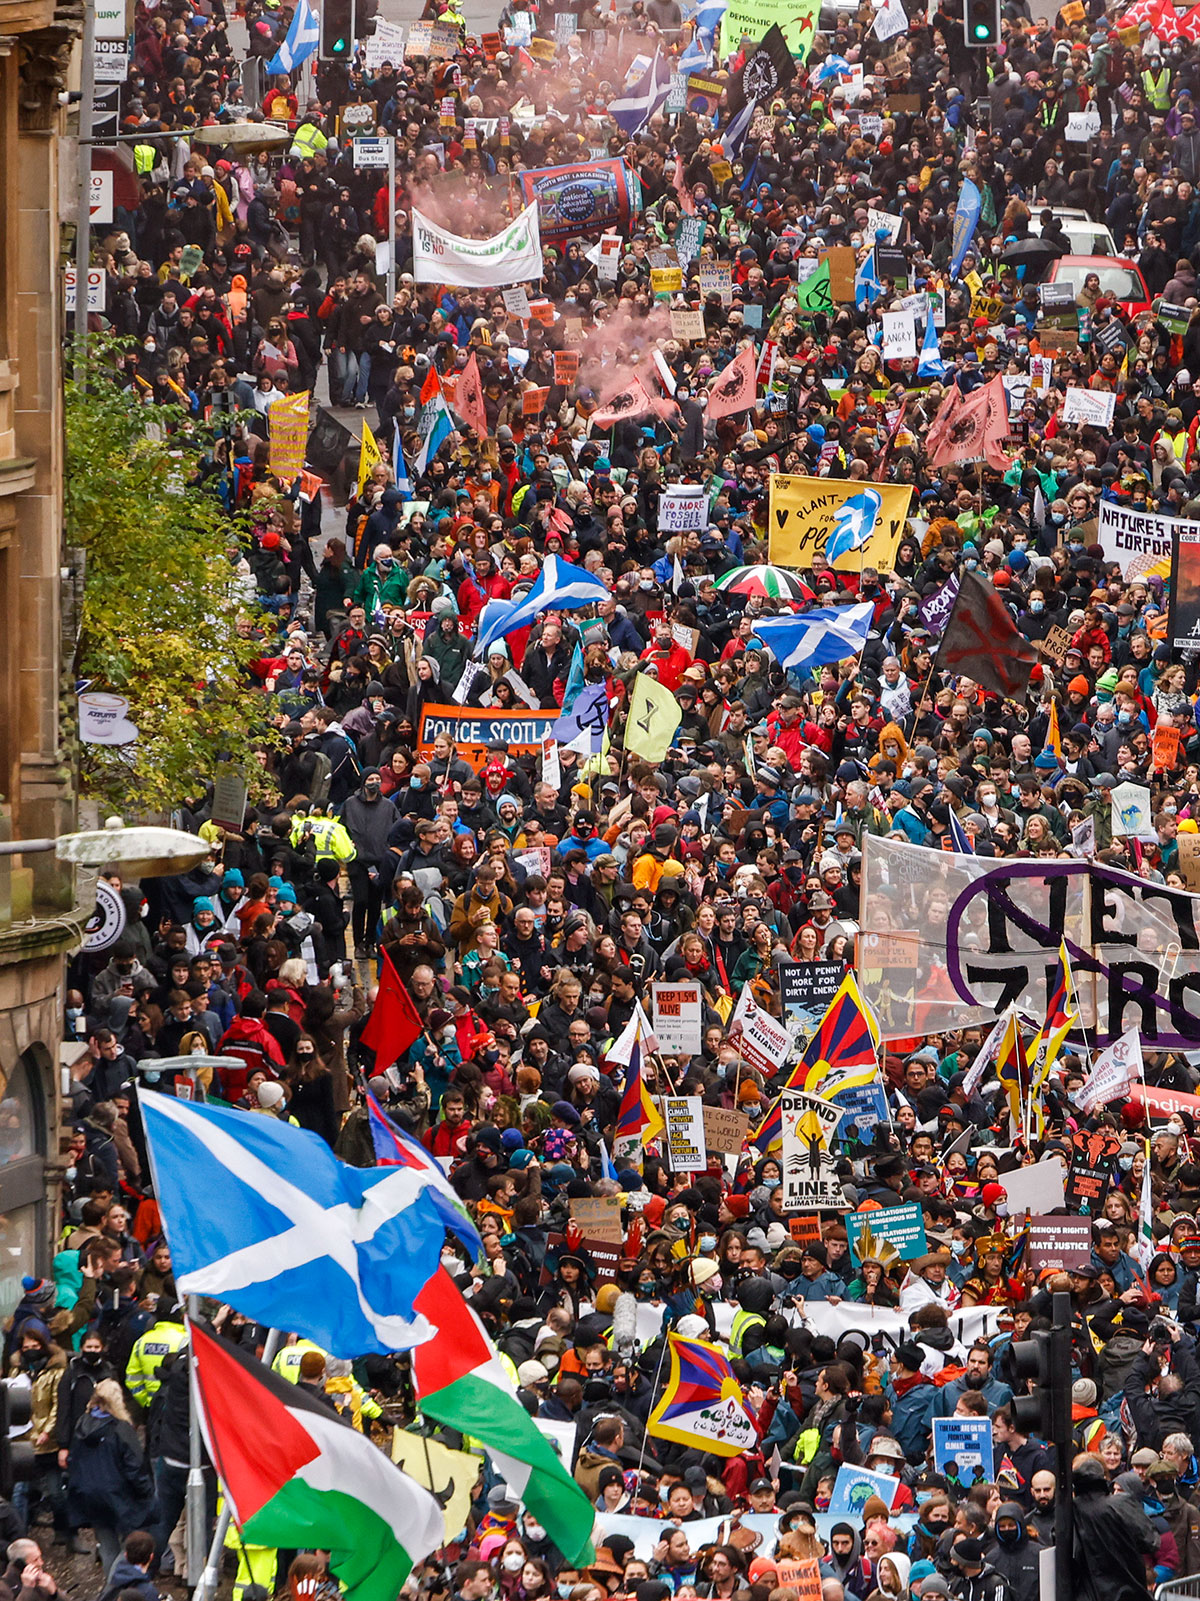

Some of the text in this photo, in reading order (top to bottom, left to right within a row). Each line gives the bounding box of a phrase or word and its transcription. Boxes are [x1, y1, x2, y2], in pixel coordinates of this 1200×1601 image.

[1069, 122, 1082, 130] No
[371, 155, 385, 163] Stop
[537, 172, 609, 190] SOUTH WEST LANCASHIRE
[563, 191, 588, 202] national
[562, 199, 590, 208] education
[568, 206, 586, 214] union
[875, 211, 890, 221] WE
[683, 219, 701, 227] STOP
[680, 233, 698, 242] STOP
[422, 241, 431, 252] IS
[433, 244, 444, 256] NO
[974, 299, 1002, 319] NO!
[886, 331, 912, 342] ANGRY
[1006, 377, 1024, 385] EAT
[662, 500, 705, 510] NO MORE
[666, 510, 701, 520] FOSSIL
[669, 519, 700, 529] FUELS
[1101, 509, 1165, 537] NATURE'S
[1114, 529, 1172, 552] CORPOR
[1181, 534, 1198, 542] CODE
[1174, 639, 1191, 647] COMING
[424, 717, 552, 743] POLICE SCOTLA
[784, 965, 841, 977] NOT A PENNY
[791, 976, 836, 987] MORE FOR
[656, 990, 675, 1002] KEEP
[785, 987, 809, 997] DIRTY
[659, 1004, 680, 1015] ALIVE
[748, 1027, 780, 1058] ALLIANCE
[717, 1139, 734, 1151] US
[789, 1181, 842, 1197] LINE 3
[876, 1206, 918, 1218] RELATIONSHIP
[878, 1226, 921, 1237] RELATIONSHIP
[1060, 1227, 1088, 1235] RIGHTS
[1053, 1241, 1088, 1251] JUSTICE
[592, 1250, 618, 1261] RIGHTS
[145, 1343, 169, 1354] POLICE
[961, 1424, 970, 1432] ARE
[945, 1442, 965, 1450] CLIMATE
[781, 1566, 819, 1580] CLIMATE
